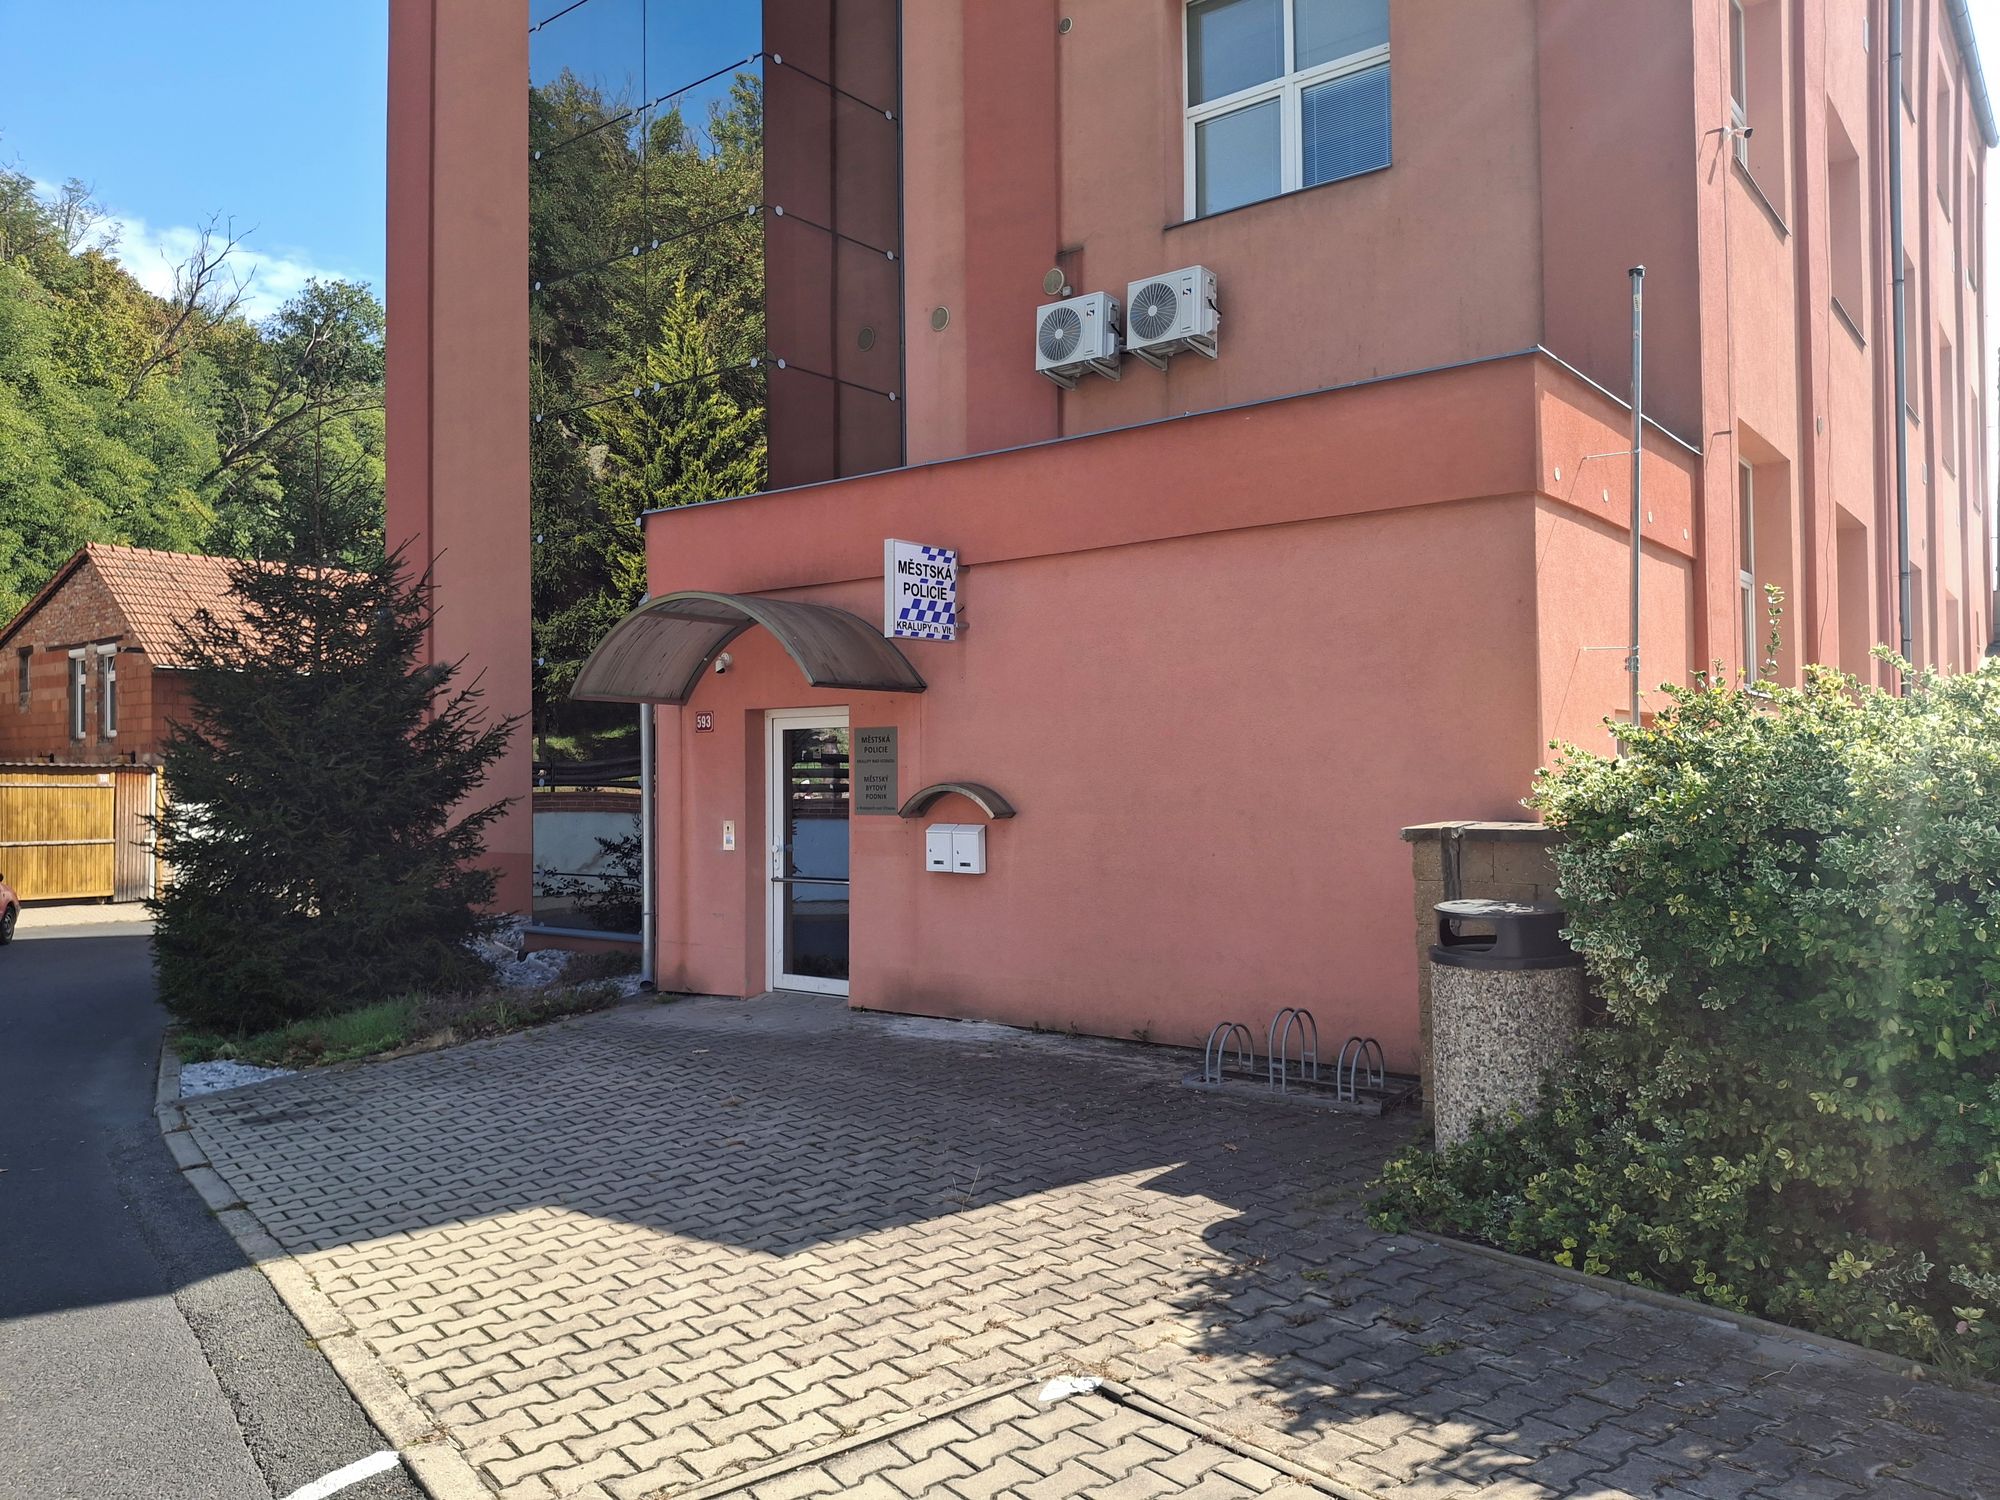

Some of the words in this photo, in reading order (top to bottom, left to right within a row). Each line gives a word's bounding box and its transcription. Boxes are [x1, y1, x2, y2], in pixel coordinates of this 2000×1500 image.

[898, 559, 953, 581] MĚSTSKÁ
[903, 582, 948, 600] POLICIE
[896, 620, 932, 632] KRALUPY
[697, 715, 711, 728] 593
[861, 734, 891, 744] MĚSTSKÁ
